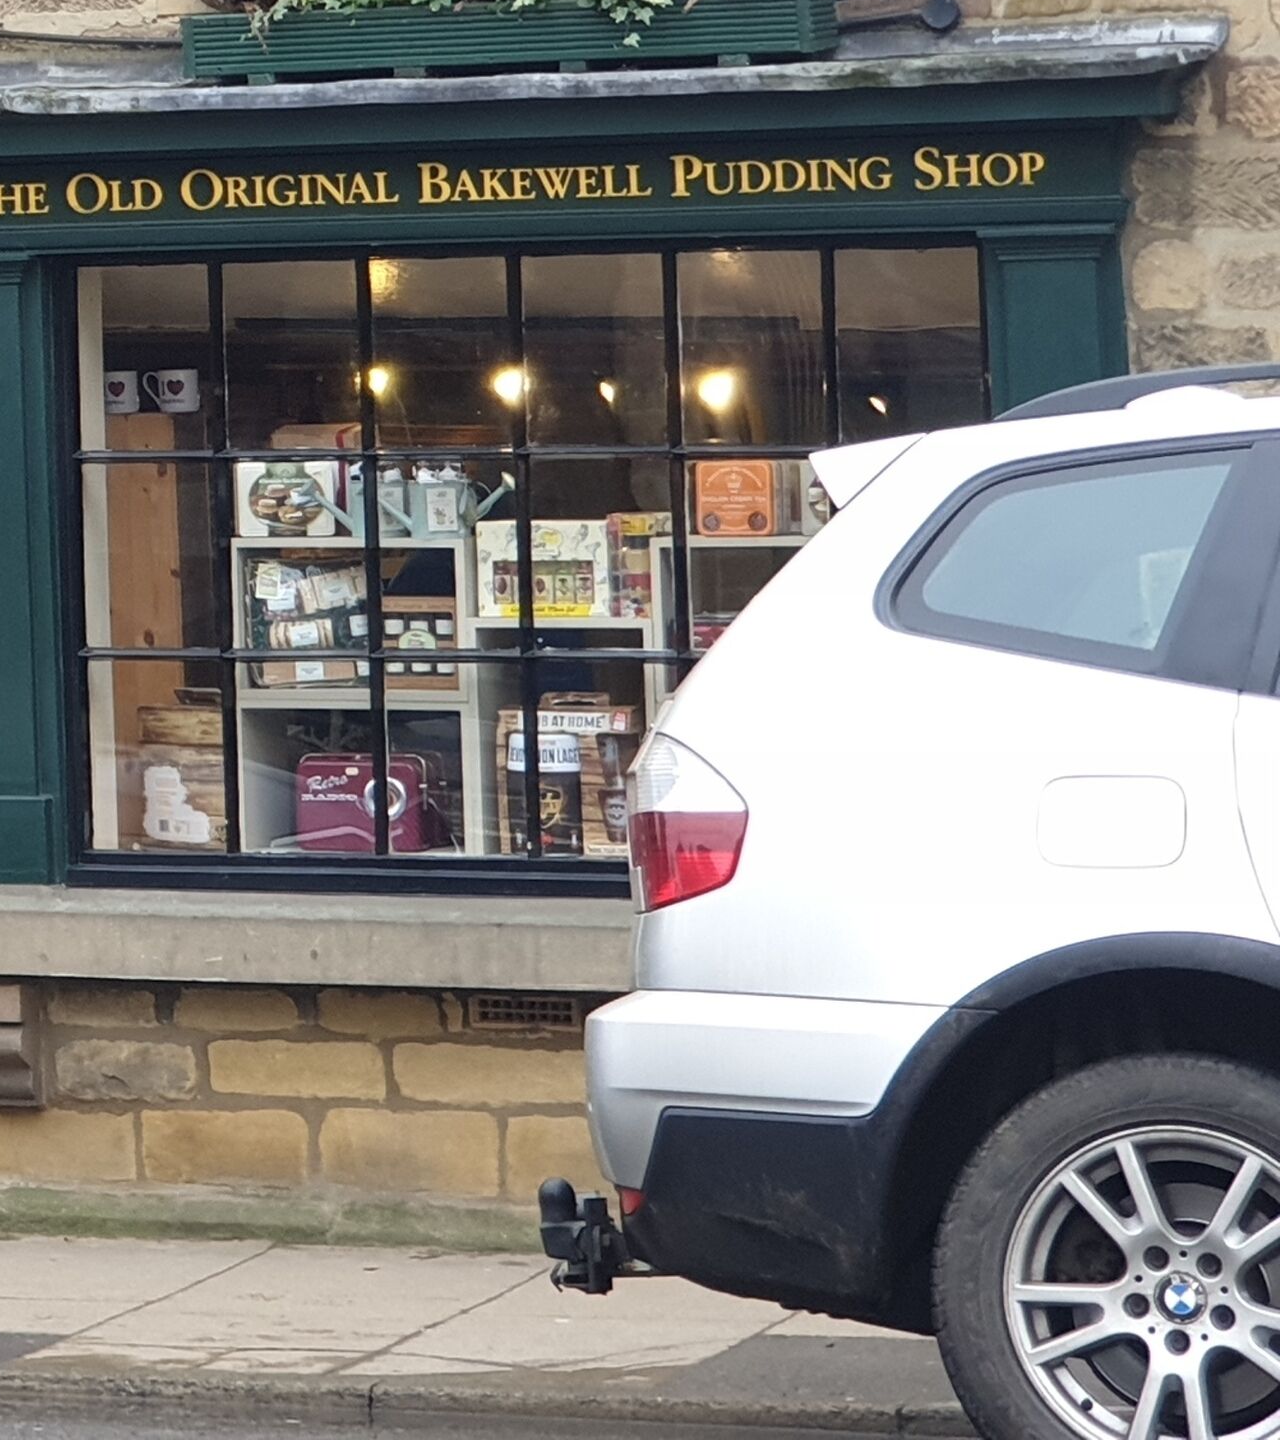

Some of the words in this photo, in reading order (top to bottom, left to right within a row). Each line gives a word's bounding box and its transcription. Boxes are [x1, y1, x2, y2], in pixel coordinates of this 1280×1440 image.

[67, 173, 163, 214] OLD
[179, 169, 399, 211] ORIGINAL
[418, 162, 651, 203] BAKEWELL
[671, 153, 894, 196] PUDDING
[914, 145, 1048, 189] SHOP
[552, 716, 564, 726] AT
[568, 715, 602, 728] HOME
